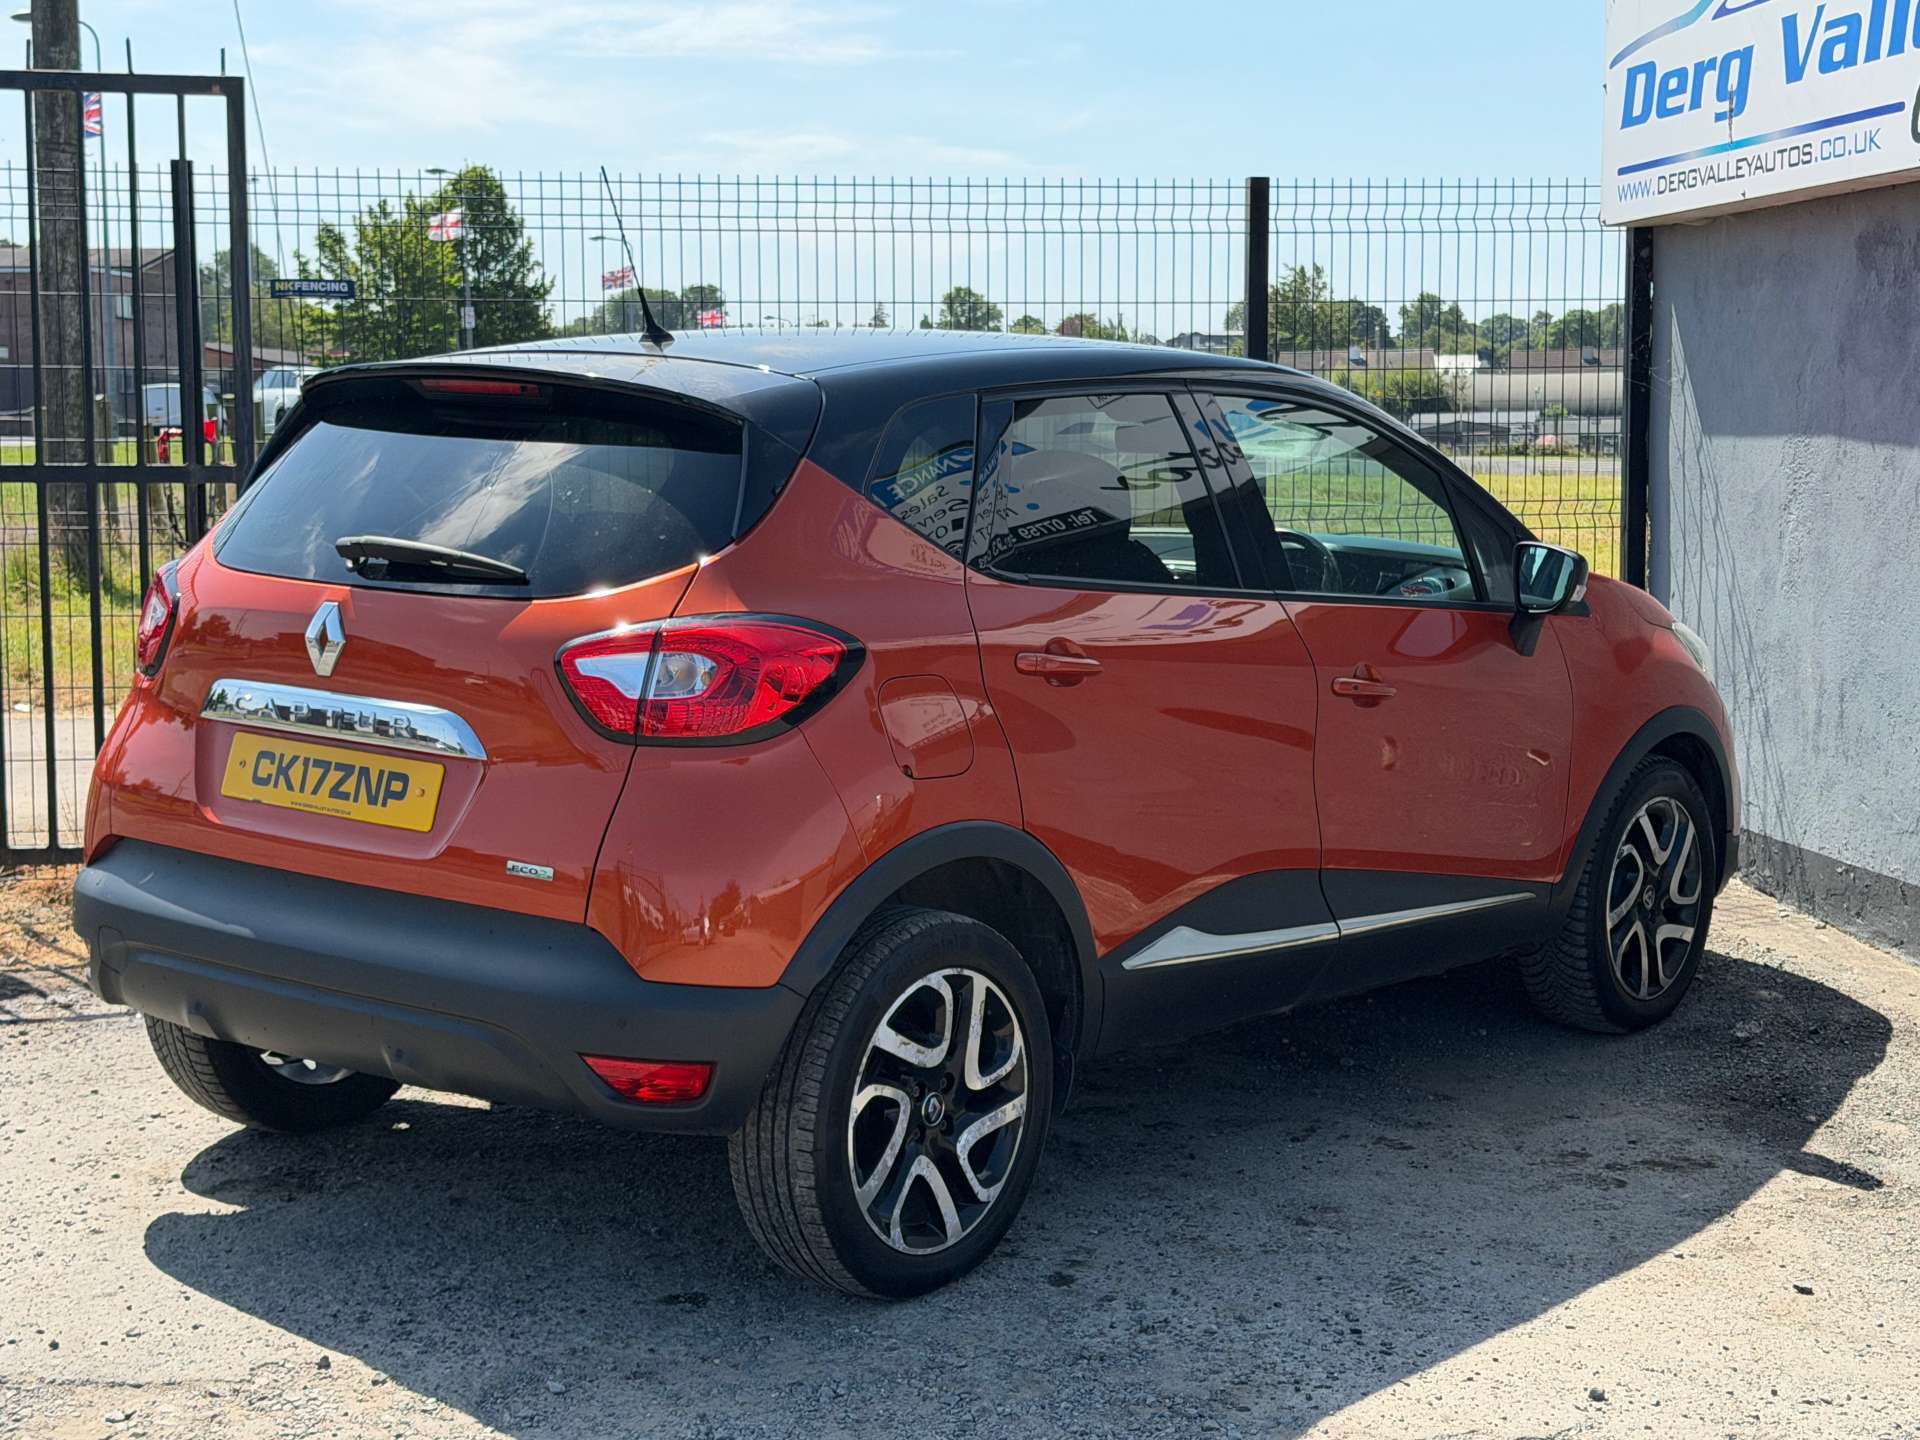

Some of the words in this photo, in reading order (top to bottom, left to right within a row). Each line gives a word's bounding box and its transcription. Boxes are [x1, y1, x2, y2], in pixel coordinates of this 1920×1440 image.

[1620, 44, 1755, 130] Derg
[1781, 0, 1920, 85] Vall
[1617, 127, 1882, 203] WWW.DERGVALLEYAUTOS.CO.UK
[250, 749, 410, 808] CK17ZNP
